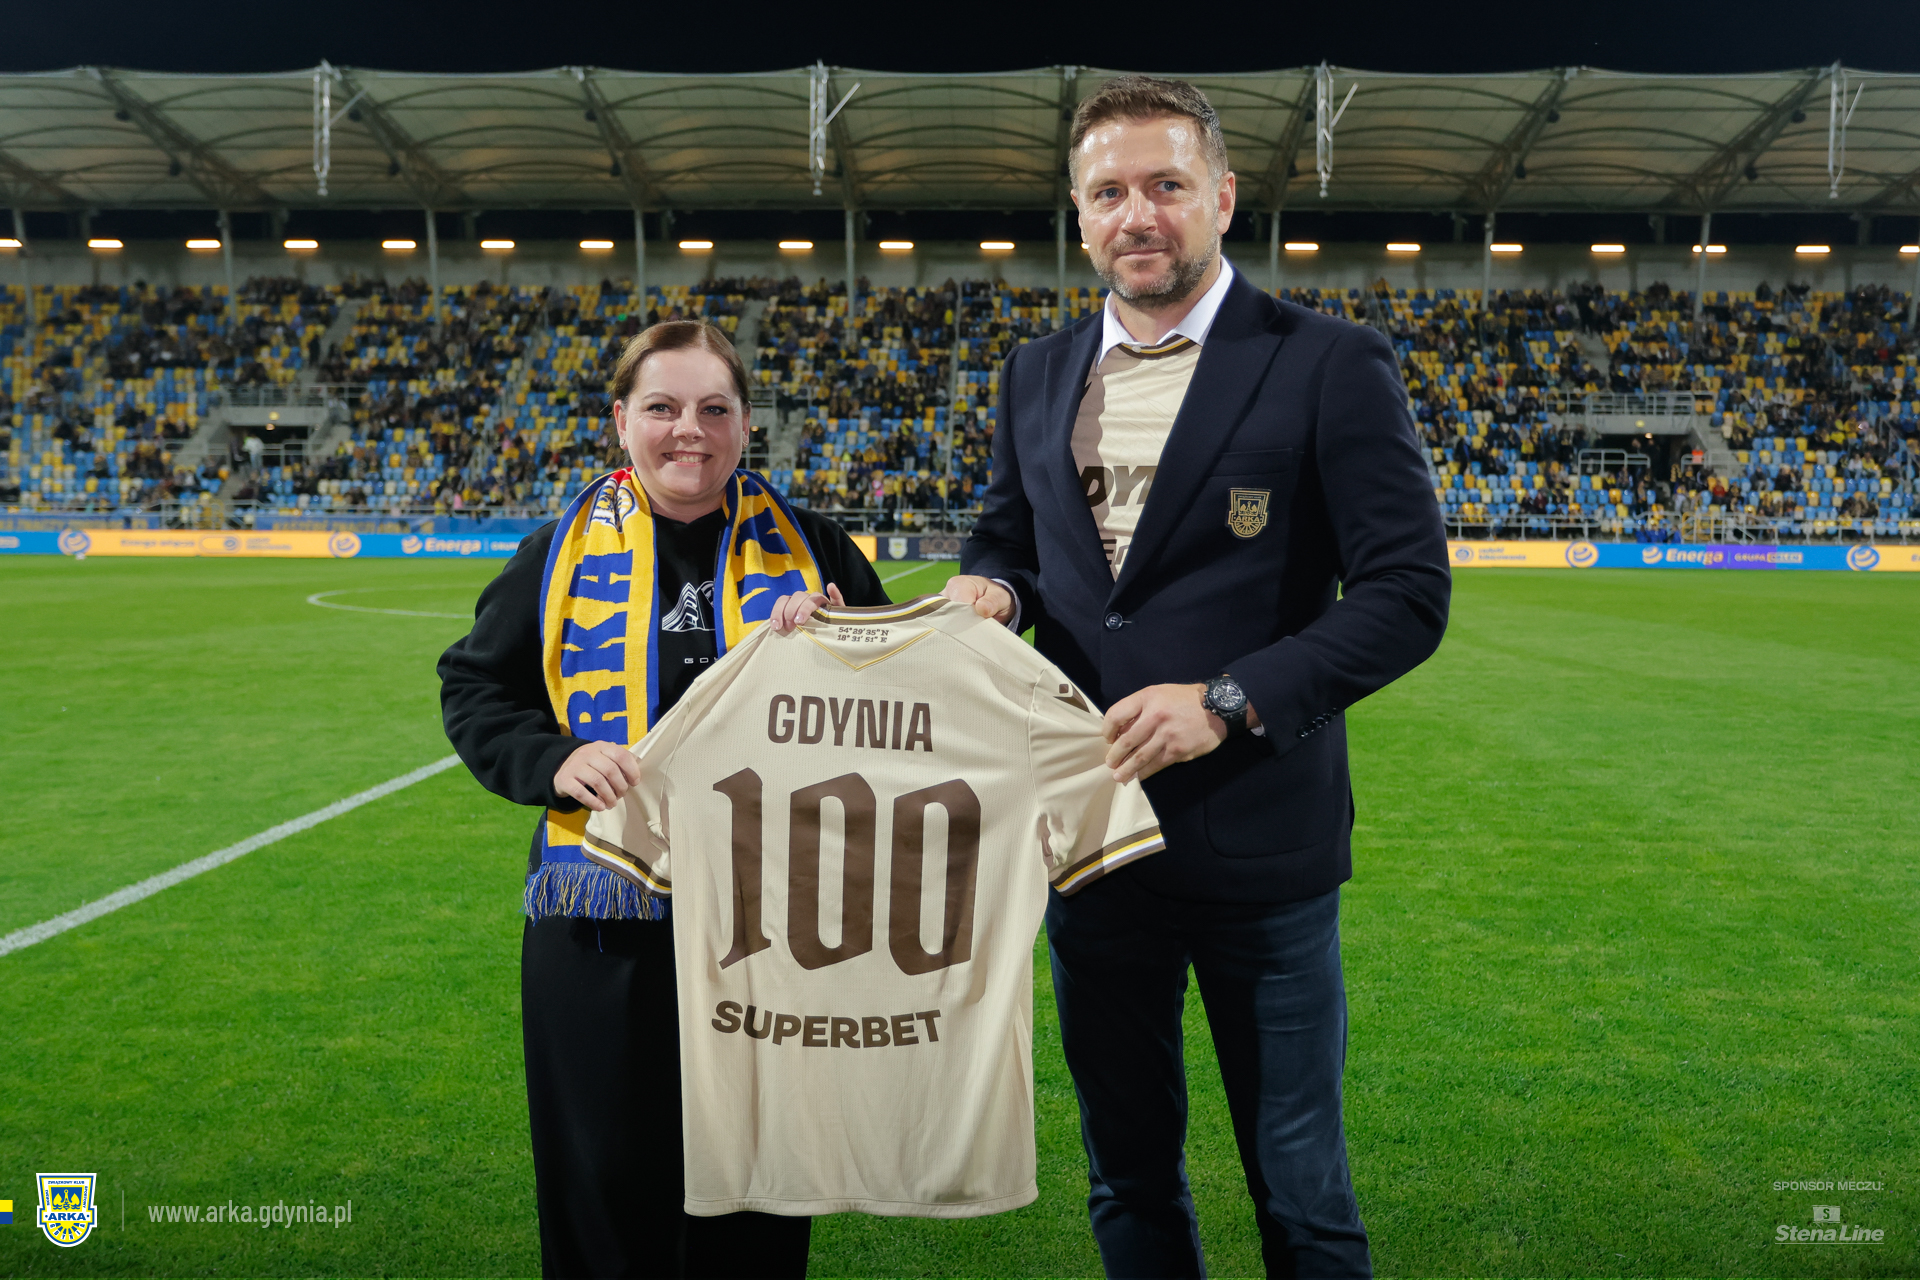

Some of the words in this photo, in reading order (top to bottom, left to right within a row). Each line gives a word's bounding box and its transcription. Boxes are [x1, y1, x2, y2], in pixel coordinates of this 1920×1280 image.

[425, 537, 481, 555] Energa
[1666, 548, 1724, 565] Energa
[561, 549, 634, 745] RKA
[768, 694, 933, 752] GDYNIA
[712, 767, 981, 975] 100
[711, 1000, 941, 1048] SUPERBET
